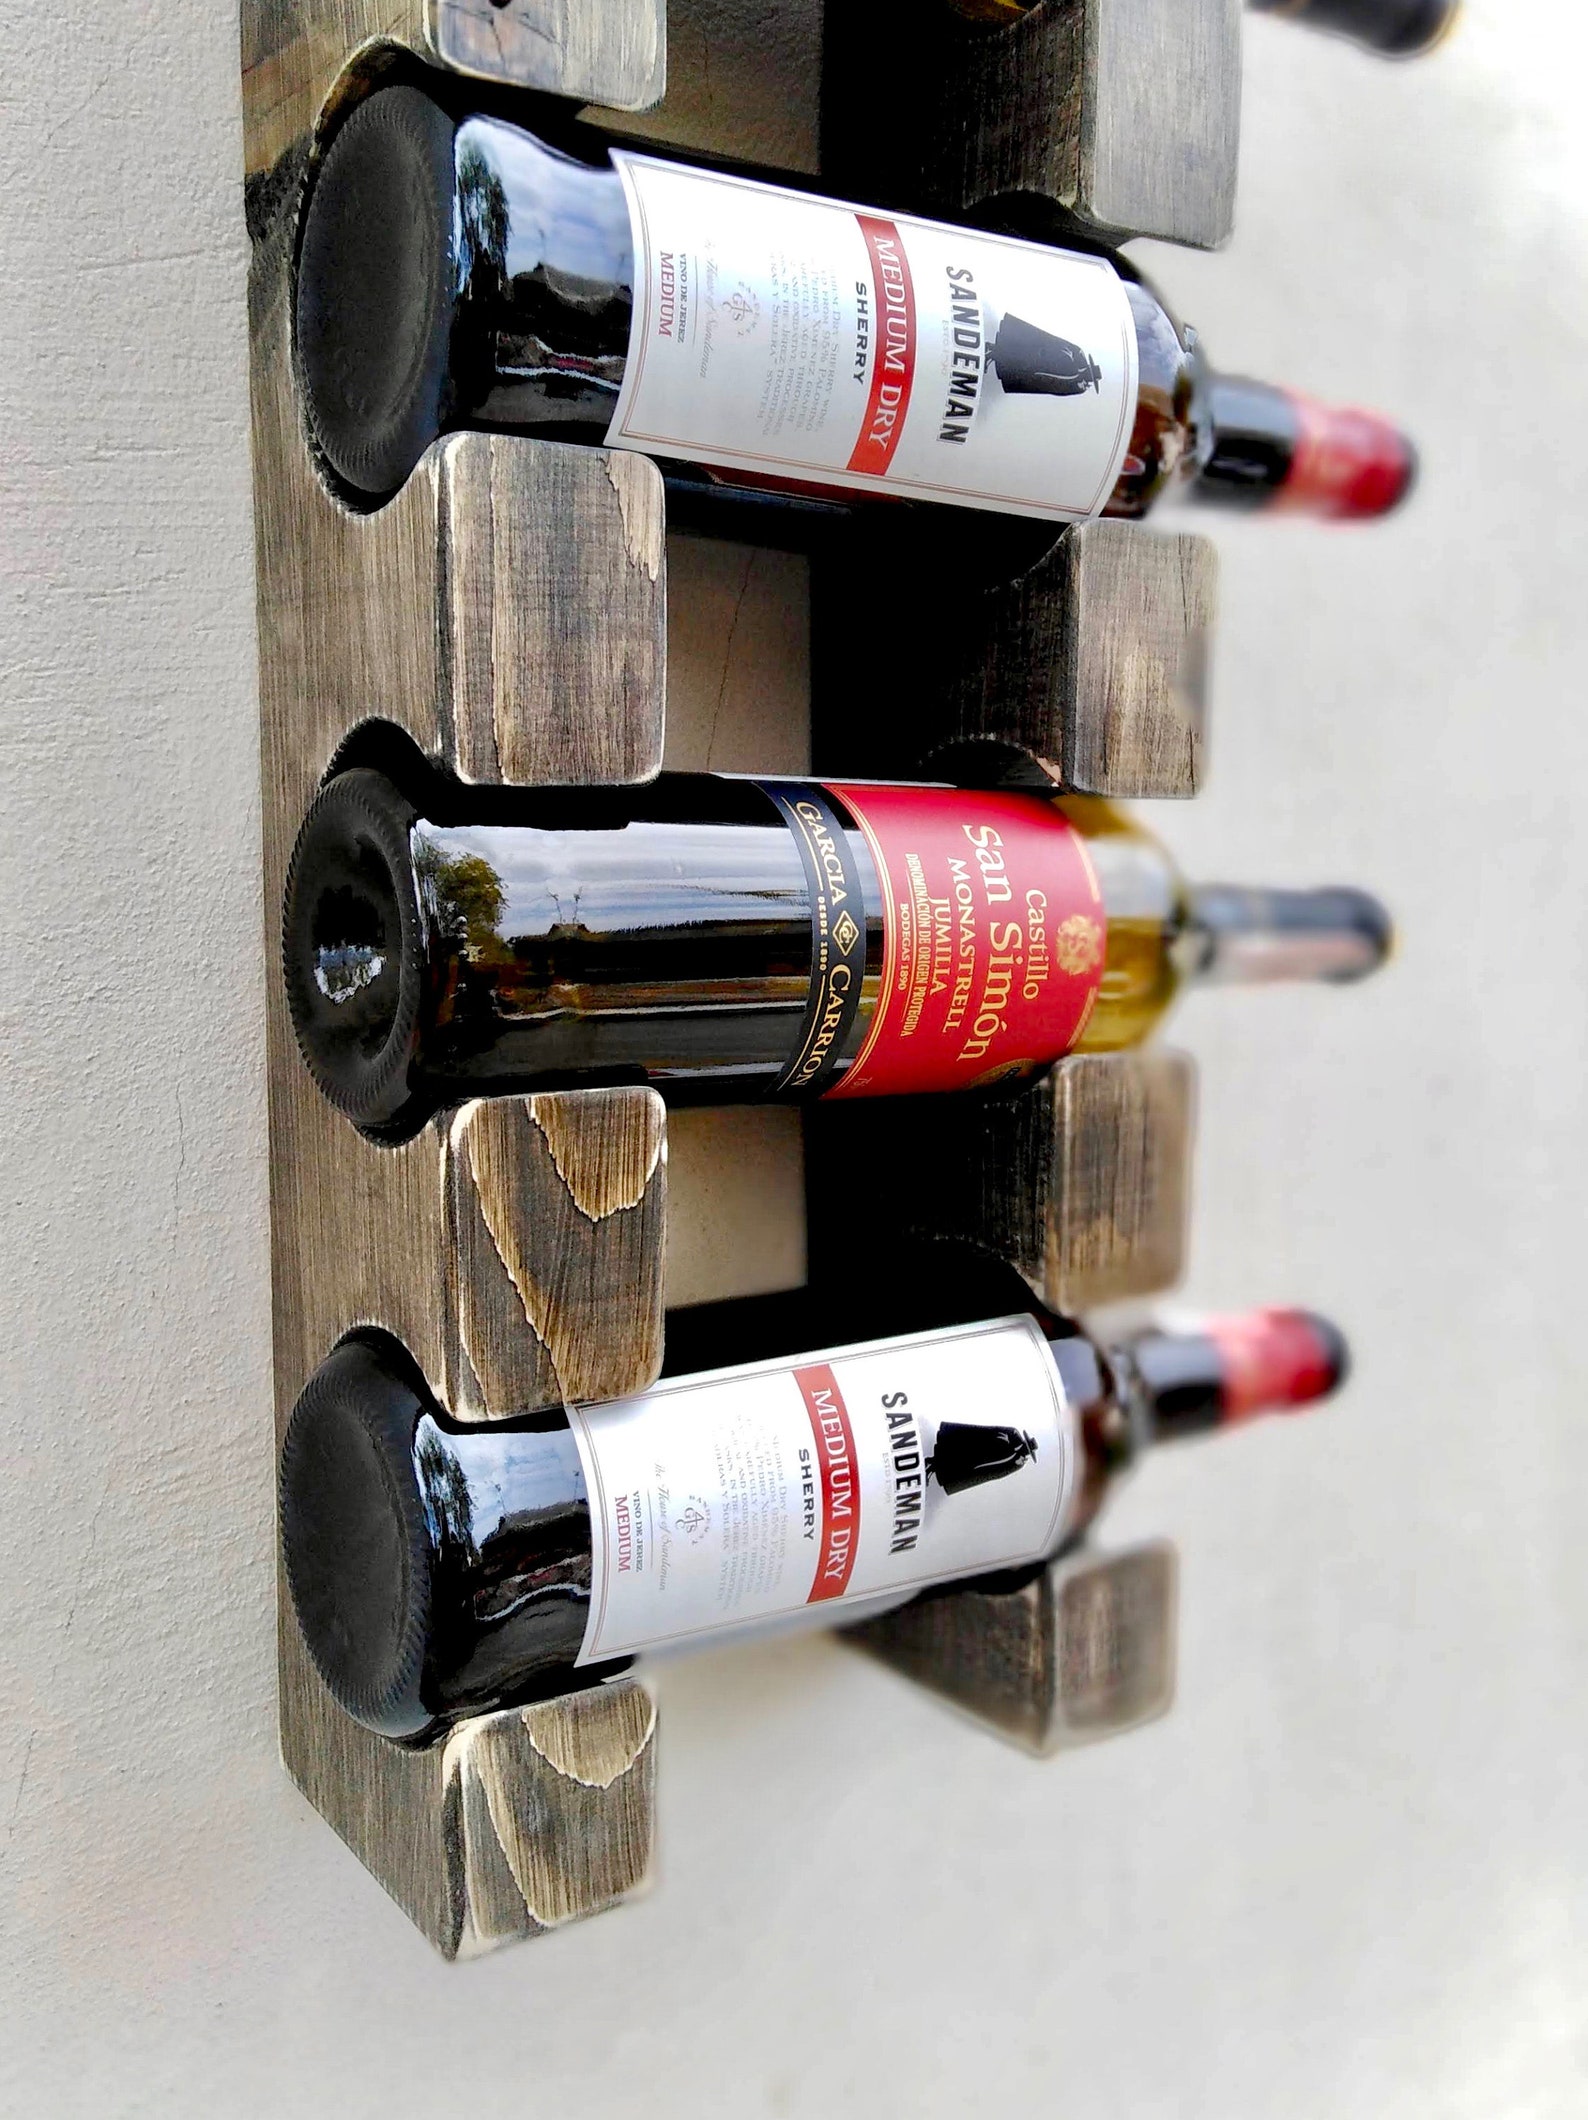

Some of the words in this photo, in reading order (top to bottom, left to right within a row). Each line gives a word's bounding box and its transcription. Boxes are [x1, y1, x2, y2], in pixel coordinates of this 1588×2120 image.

[658, 251, 675, 338] MEDIUM
[679, 253, 687, 282] VINO
[679, 285, 687, 302] DE
[874, 236, 907, 373] MEDIUM
[677, 304, 687, 344] JEREZ
[853, 281, 868, 385] SHERRY
[938, 266, 981, 444] SANDEMAN
[869, 382, 902, 450] DRY
[795, 801, 848, 906] GARCIA
[905, 853, 934, 927] DENOMINACIÓN
[962, 825, 1015, 906] San
[817, 896, 828, 936] DESDE
[899, 903, 911, 961] BODEGAS
[918, 930, 932, 944] DE
[928, 896, 953, 996] JUMILLA
[942, 857, 976, 1033] MONASTRELL
[1022, 889, 1050, 1000] Castillo
[819, 941, 828, 971] 1890
[897, 964, 910, 991] 1890
[915, 946, 932, 984] ORIGEN
[956, 922, 1024, 1062] Simón
[791, 964, 852, 1086] CARRION
[900, 985, 927, 1037] PROTEGIDA
[810, 1388, 852, 1518] MEDIUM
[881, 1392, 923, 1556] SANDEMAN
[632, 1491, 642, 1519] VINO
[635, 1521, 643, 1537] DE
[799, 1448, 815, 1541] SHERRY
[614, 1495, 632, 1573] MEDIUM
[635, 1538, 643, 1573] JEREZ
[824, 1525, 852, 1580] DRY
